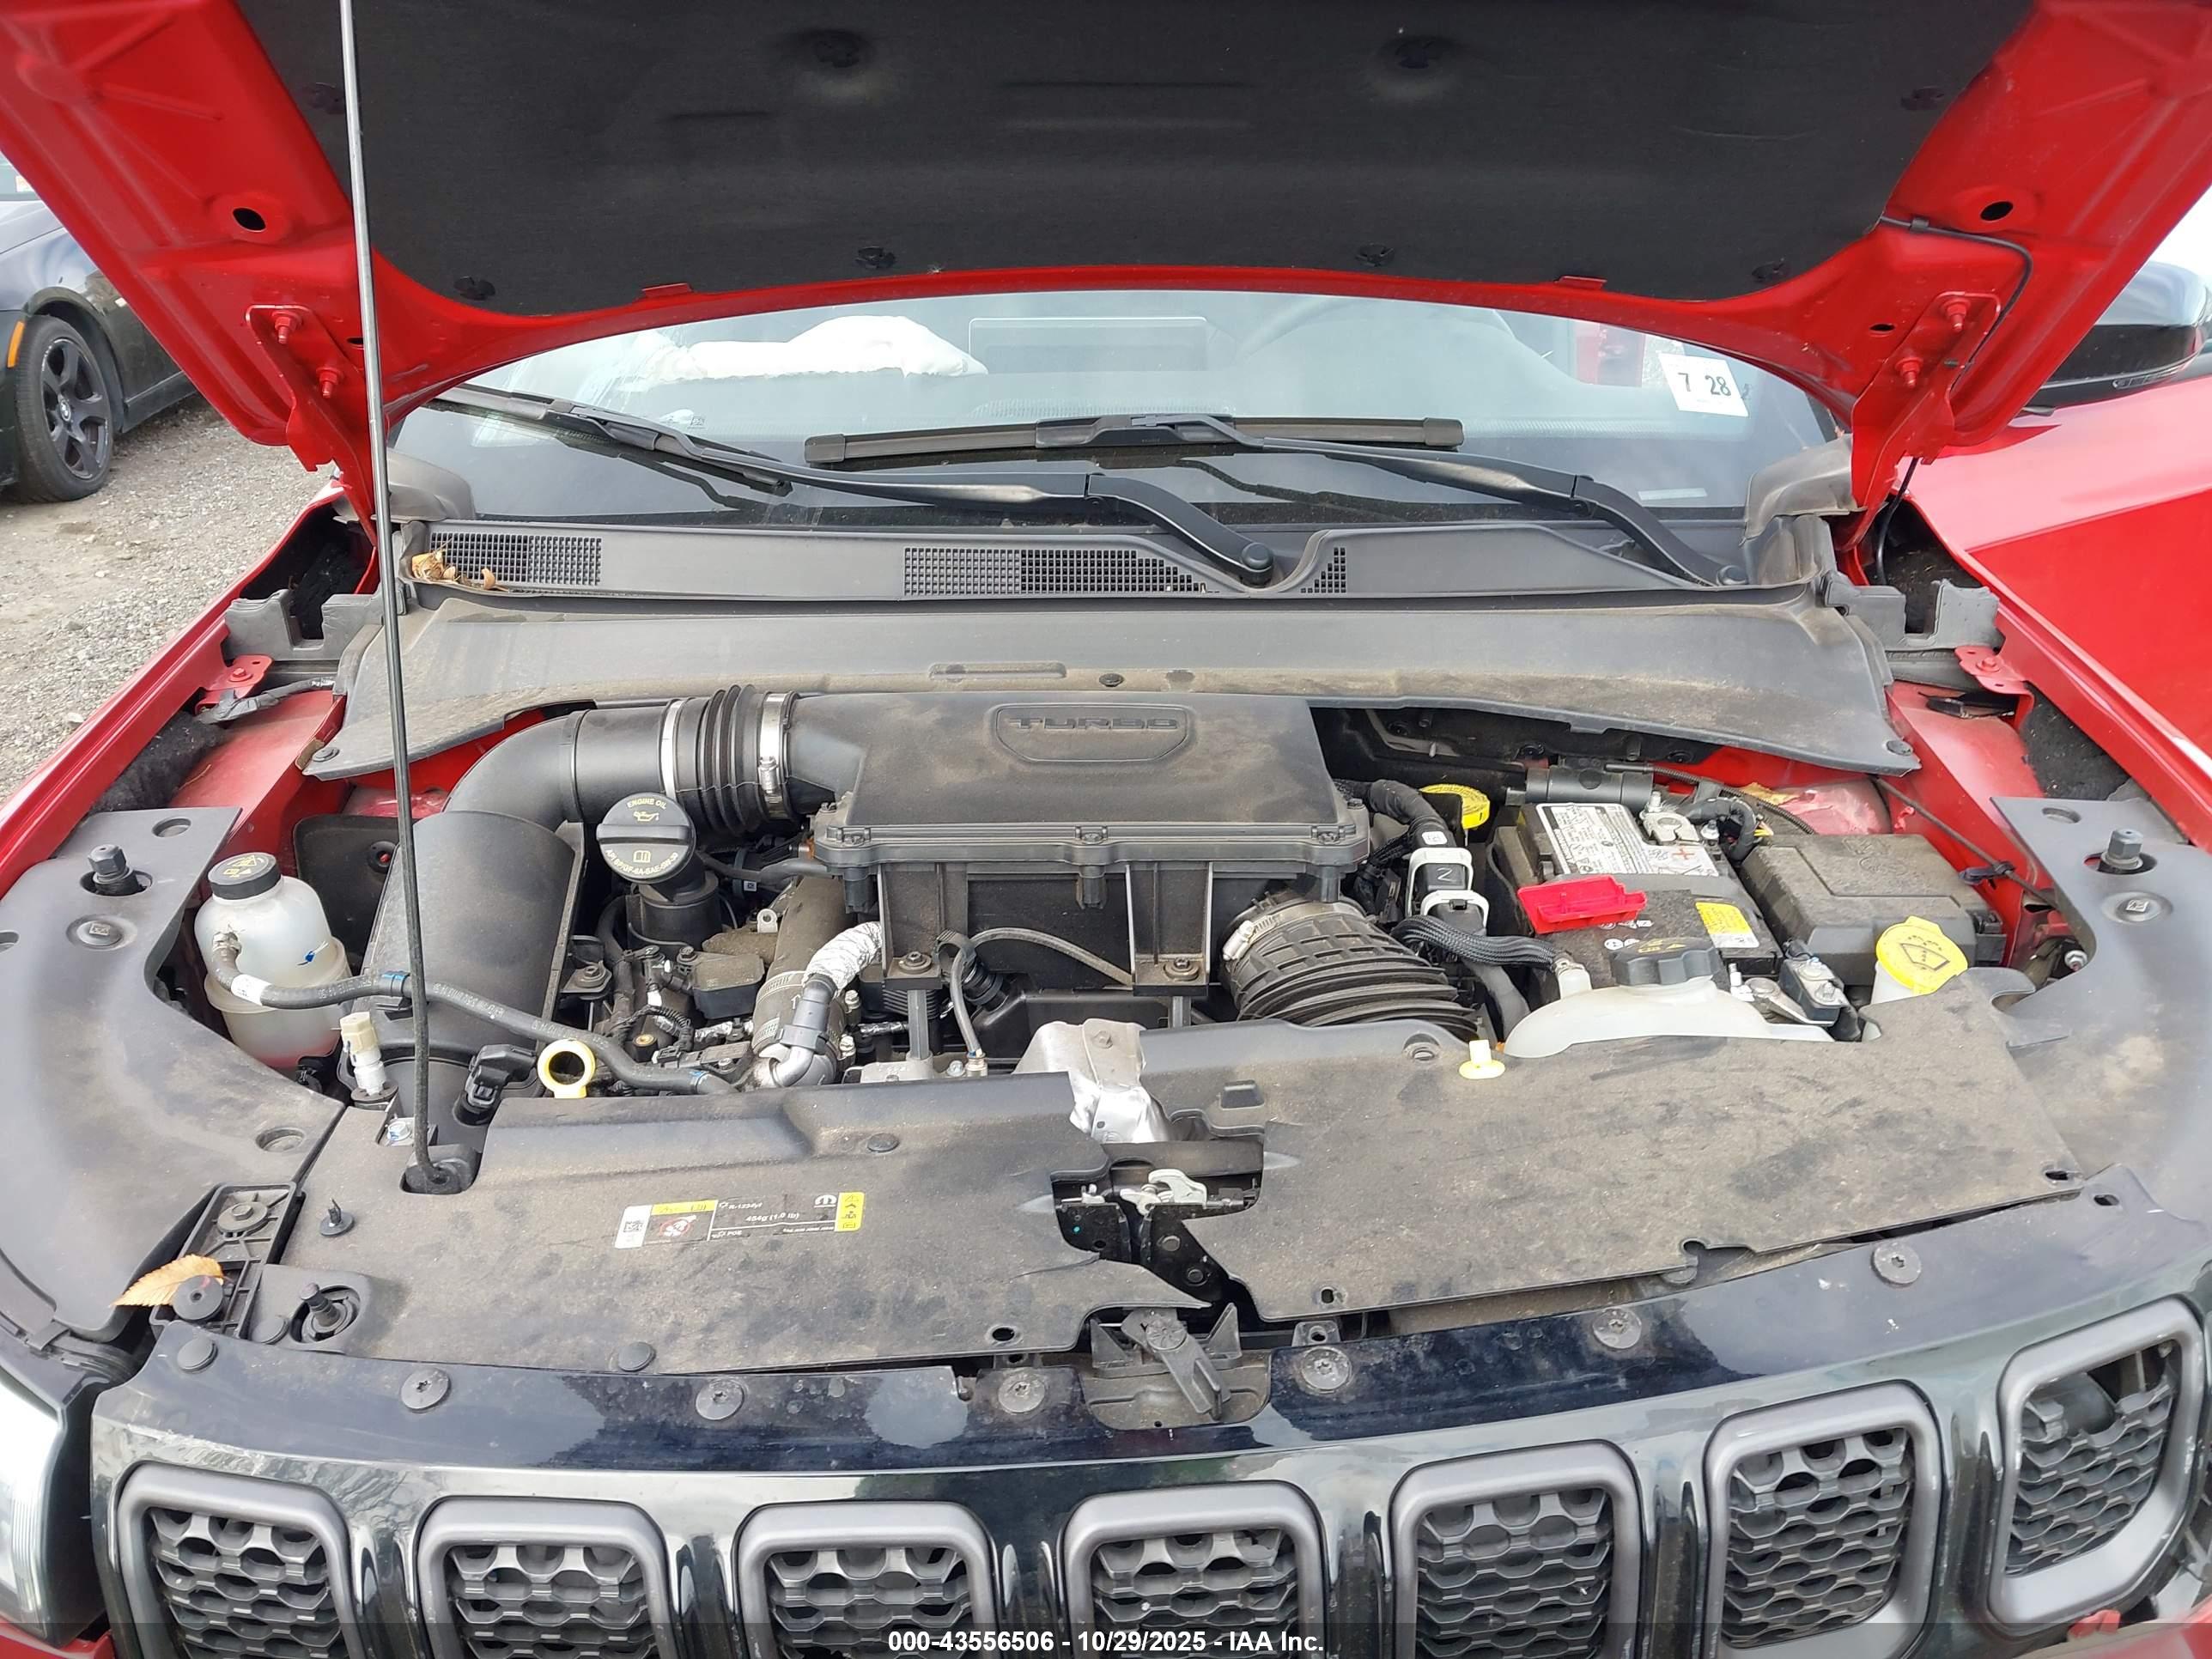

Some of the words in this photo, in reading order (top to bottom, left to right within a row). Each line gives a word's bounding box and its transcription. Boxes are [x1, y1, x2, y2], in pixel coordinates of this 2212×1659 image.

[1677, 372, 1692, 392] 7
[1705, 374, 1732, 397] 28
[1008, 717, 1179, 730] TURBO
[627, 798, 655, 808] ENGINE
[655, 799, 667, 810] OIL
